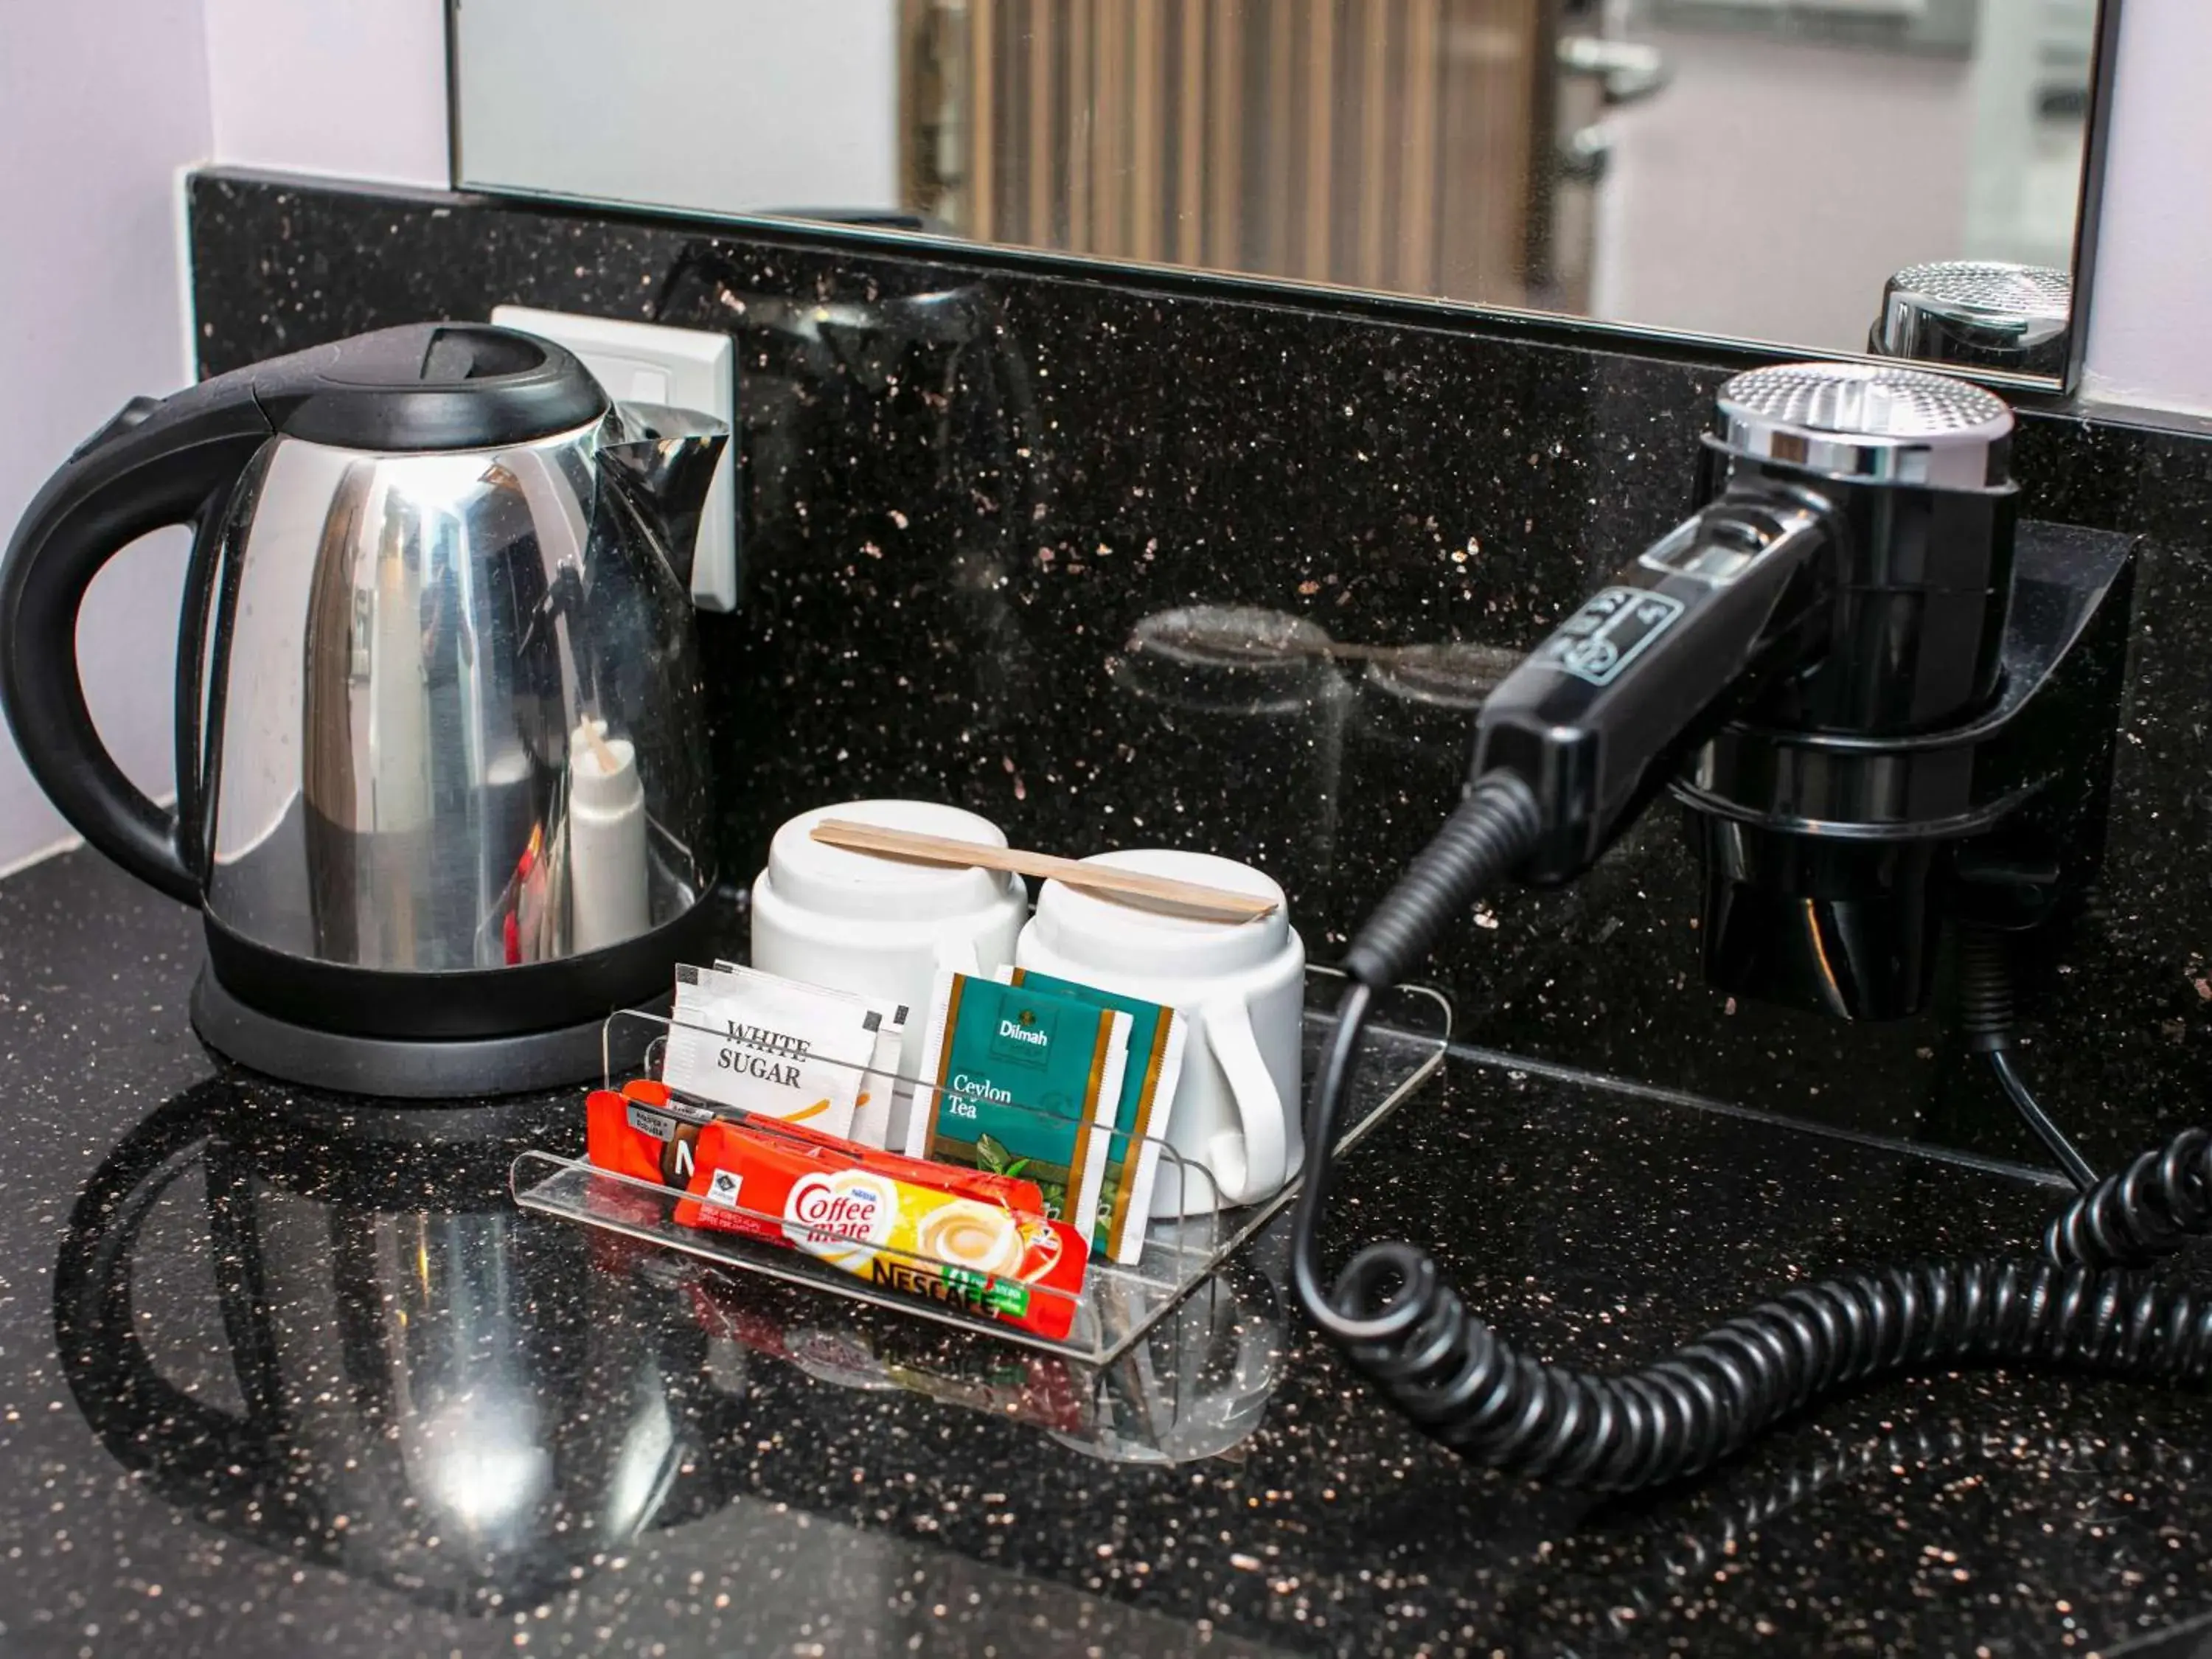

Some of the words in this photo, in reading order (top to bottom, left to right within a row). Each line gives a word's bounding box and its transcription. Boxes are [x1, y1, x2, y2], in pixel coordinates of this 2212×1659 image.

[726, 1020, 811, 1062] WHITE
[999, 1020, 1048, 1046] Dilmah
[717, 1048, 801, 1089] SUGAR
[953, 1074, 1012, 1103] Ceylon
[948, 1095, 977, 1119] Tea
[796, 1183, 876, 1223] Coffee
[807, 1222, 871, 1244] mate
